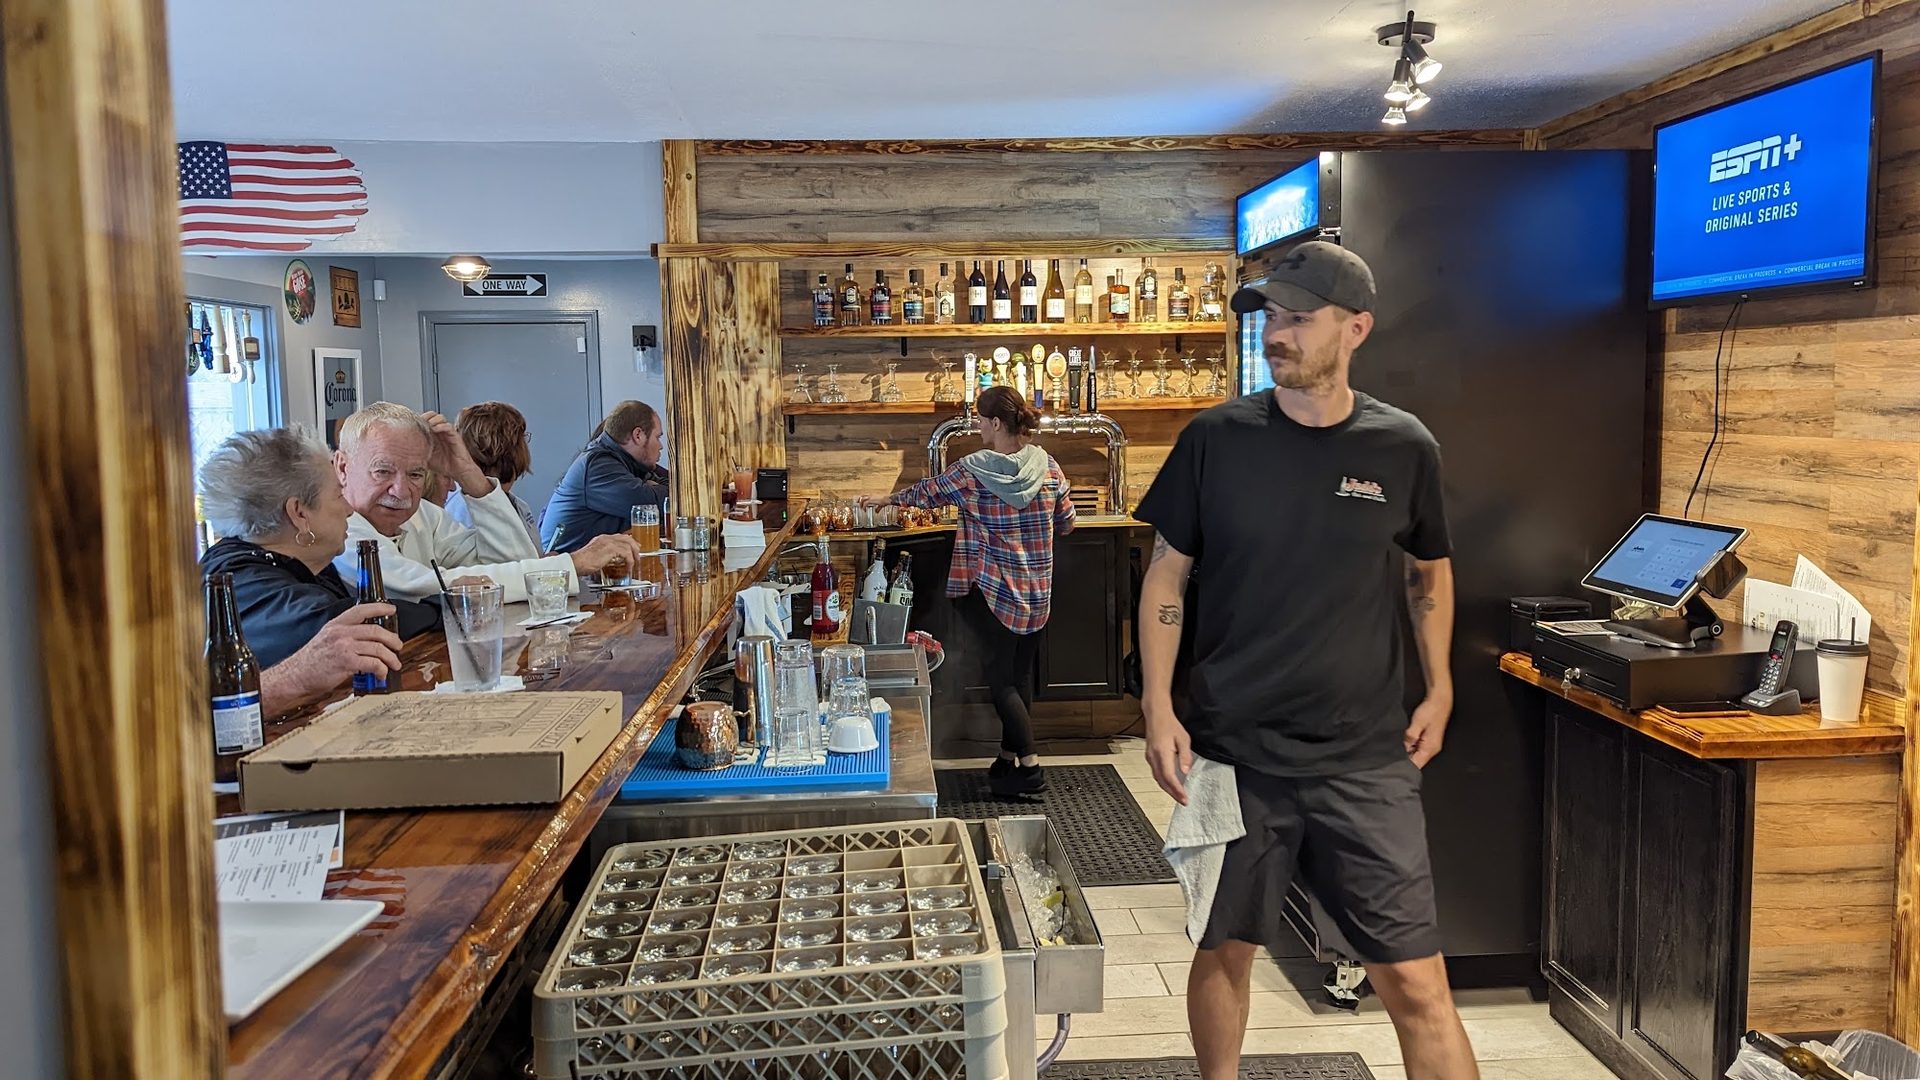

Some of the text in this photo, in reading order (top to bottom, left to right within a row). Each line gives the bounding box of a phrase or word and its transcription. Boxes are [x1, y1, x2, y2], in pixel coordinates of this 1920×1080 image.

[1712, 181, 1791, 211] LIVE SPORTS &
[1705, 201, 1798, 234] ORIGINAL SERIES
[1784, 264, 1814, 274] COMMERCIAL
[1814, 262, 1831, 270] BREAK
[1838, 257, 1864, 267] PROGRESS
[482, 280, 527, 290] ONE WAY
[325, 381, 357, 410] Corona
